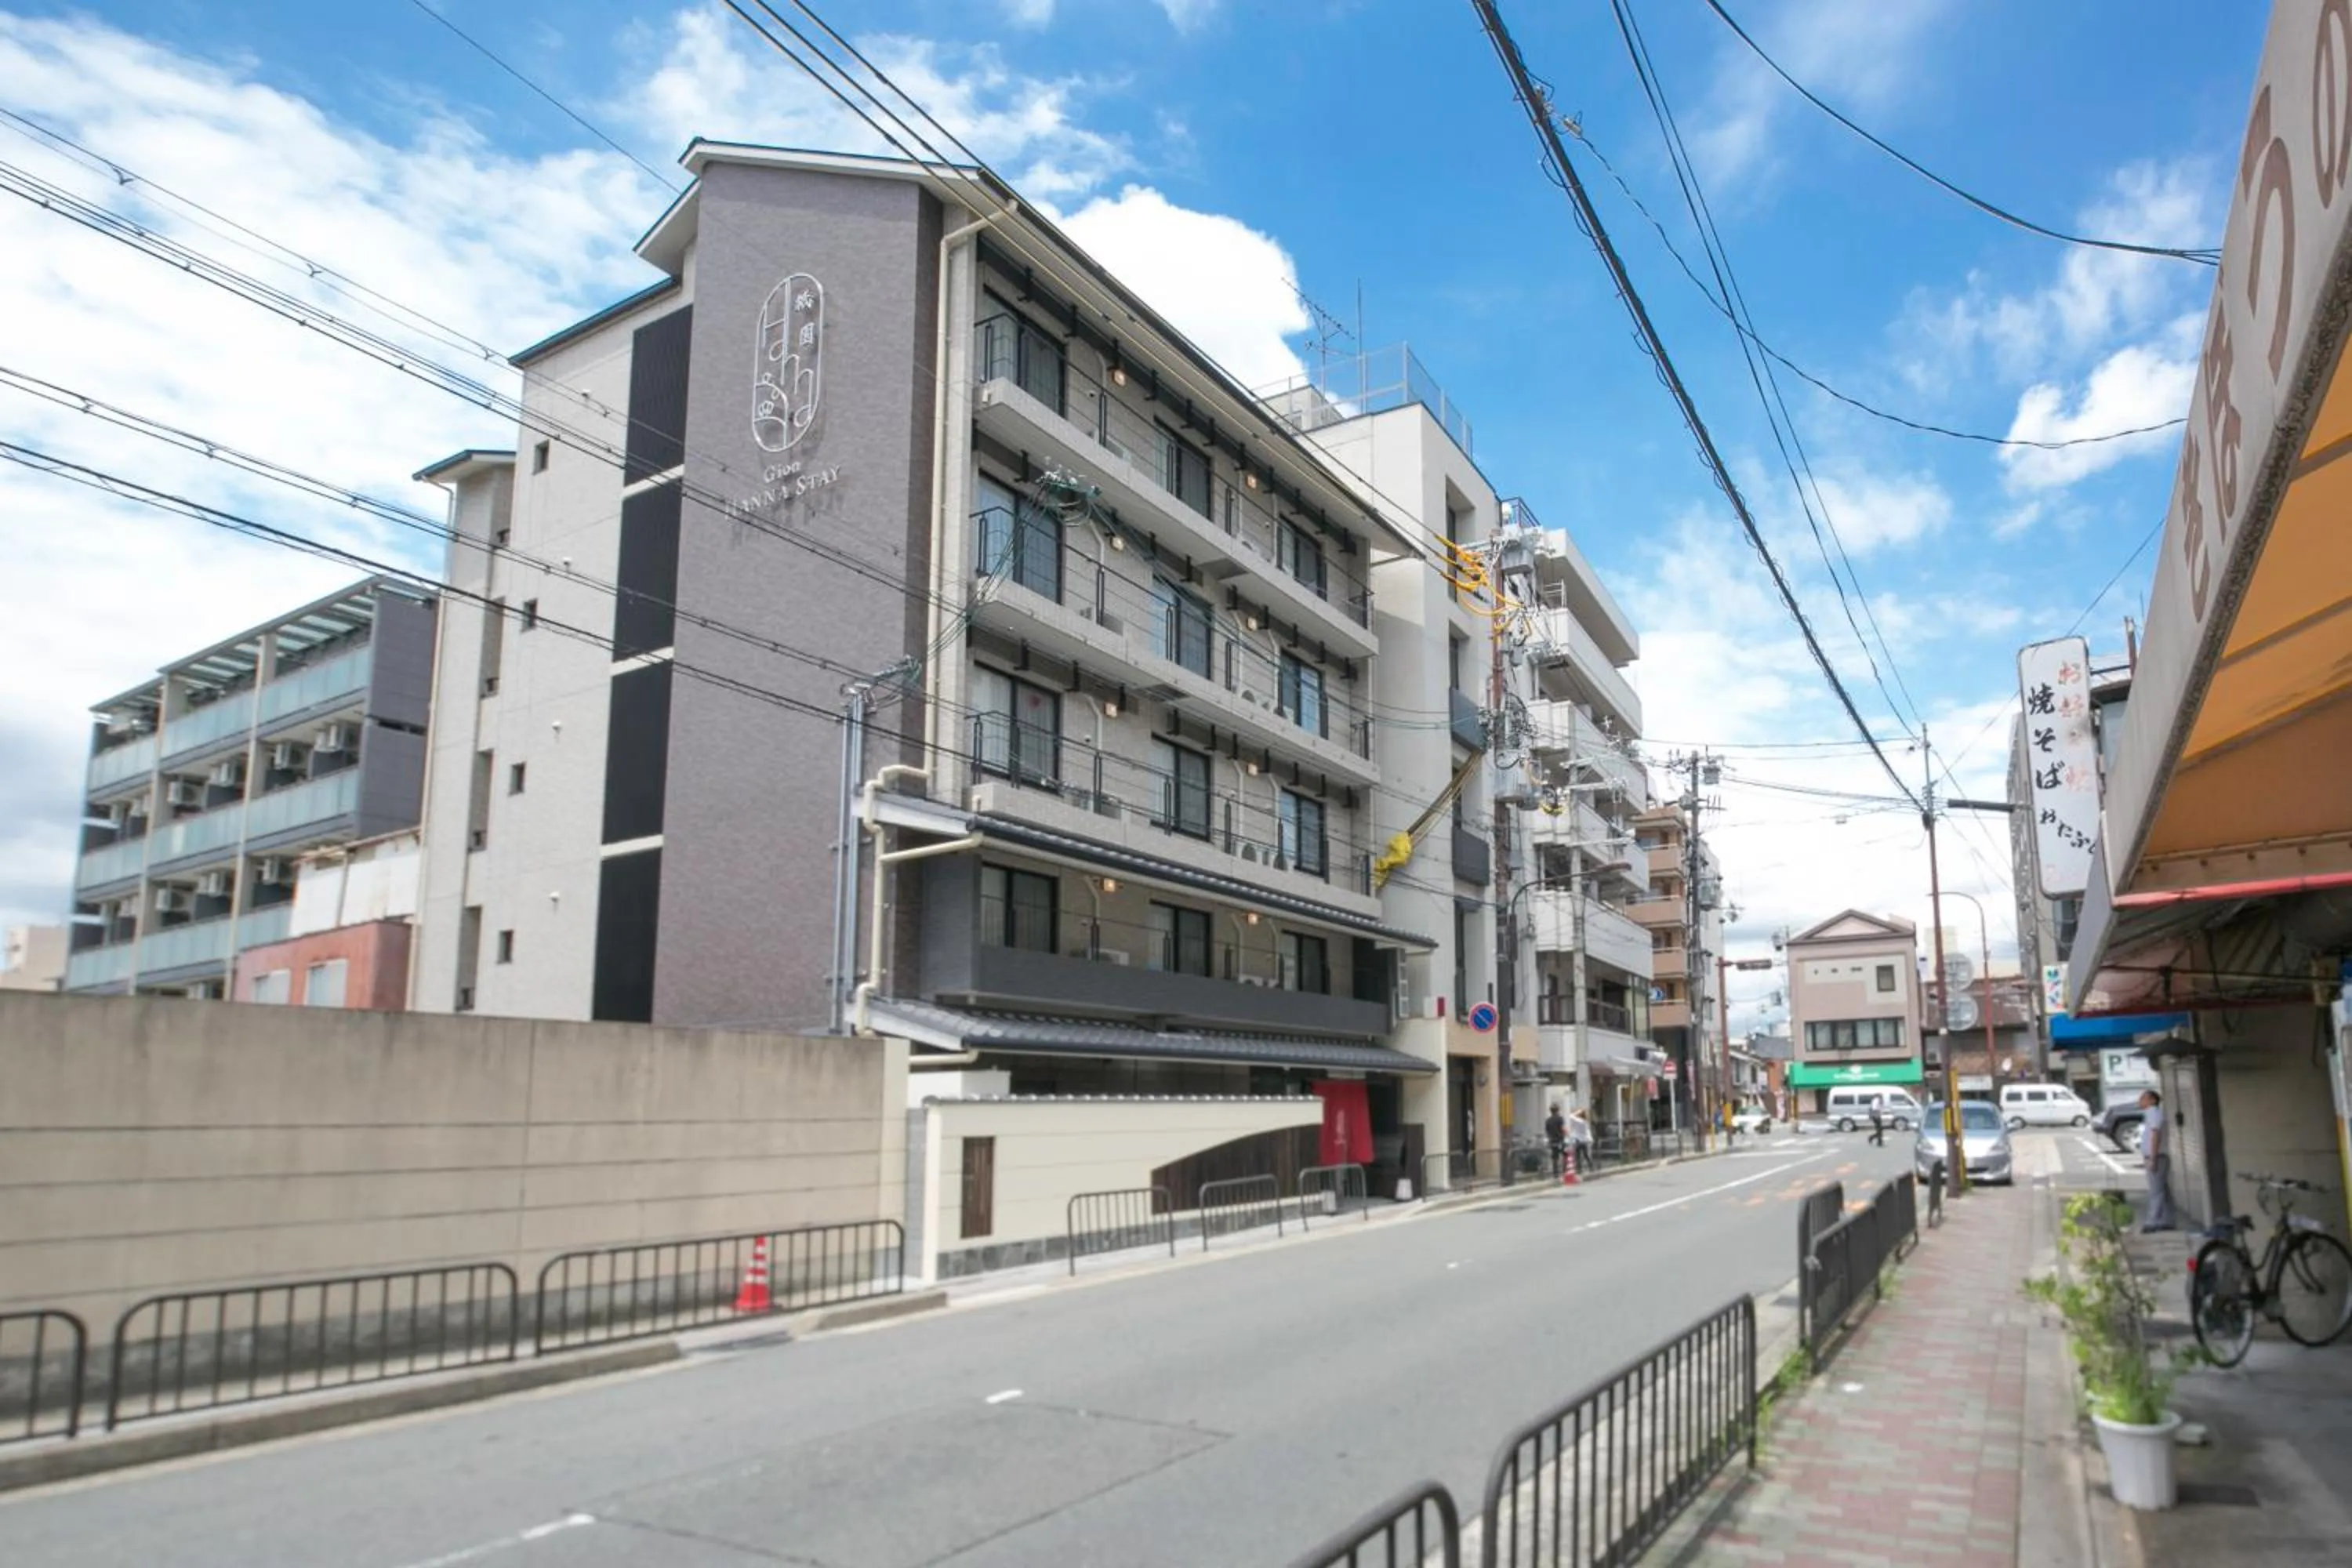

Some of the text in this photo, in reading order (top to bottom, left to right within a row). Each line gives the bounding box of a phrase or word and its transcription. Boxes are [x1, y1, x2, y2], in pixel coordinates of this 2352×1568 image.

[764, 461, 800, 483] Gion
[795, 465, 840, 495] STAY
[2027, 683, 2065, 790] 焼そば
[2109, 1055, 2122, 1071] P
